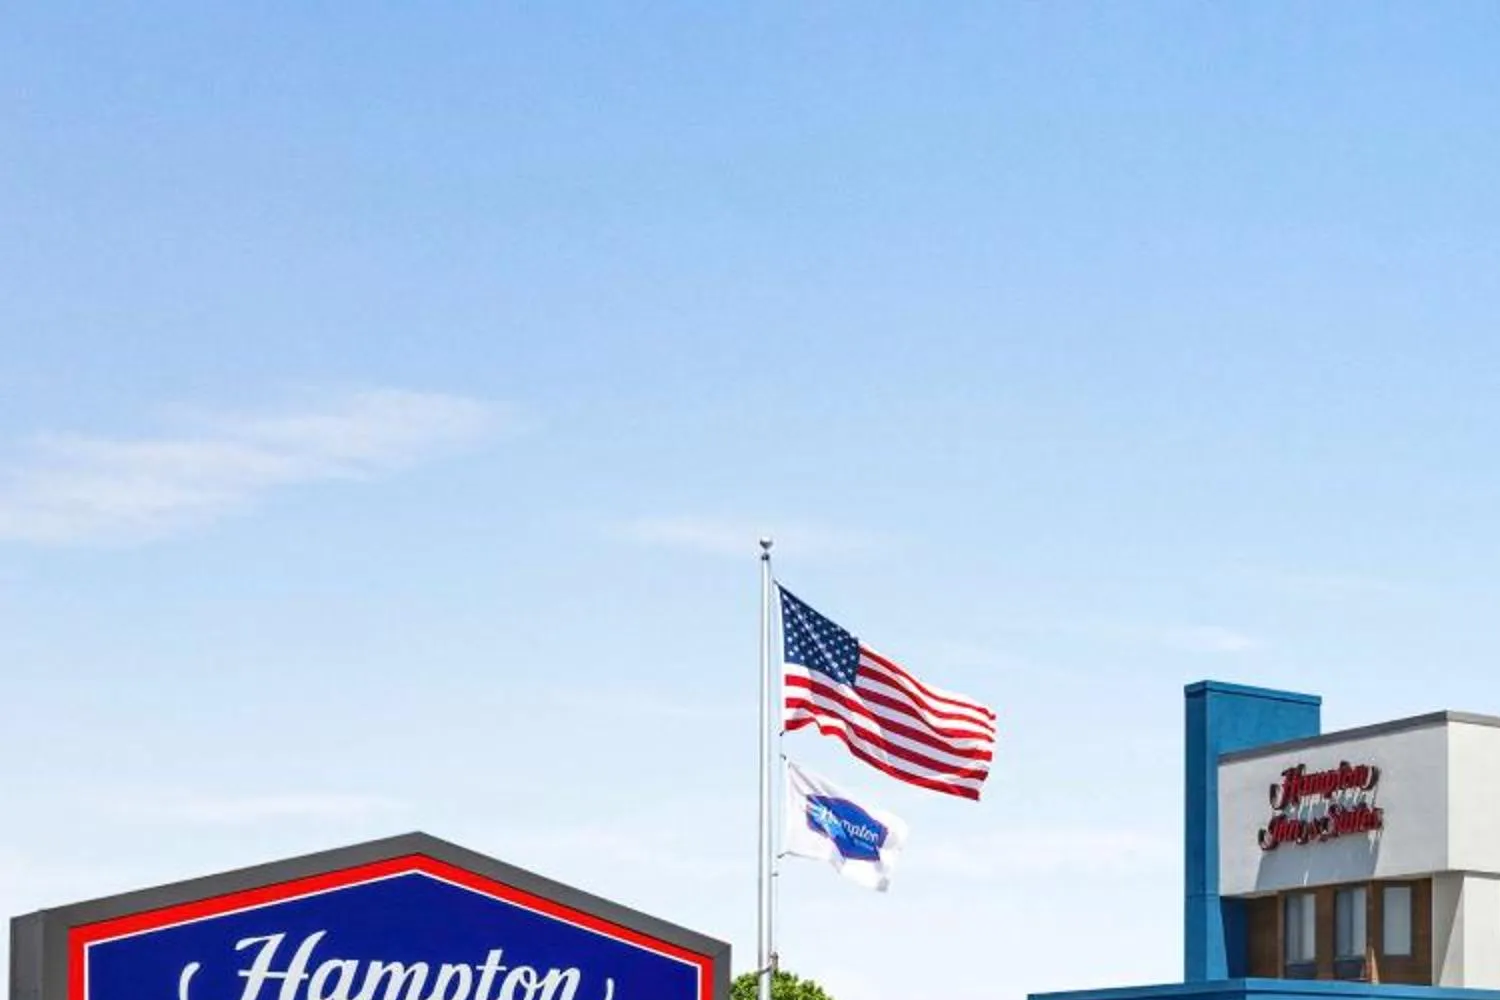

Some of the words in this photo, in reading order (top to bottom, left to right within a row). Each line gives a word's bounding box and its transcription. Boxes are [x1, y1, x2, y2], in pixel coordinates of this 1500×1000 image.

[1269, 760, 1381, 810] Hampton
[1258, 815, 1309, 851] Inn
[1326, 802, 1384, 838] Suites
